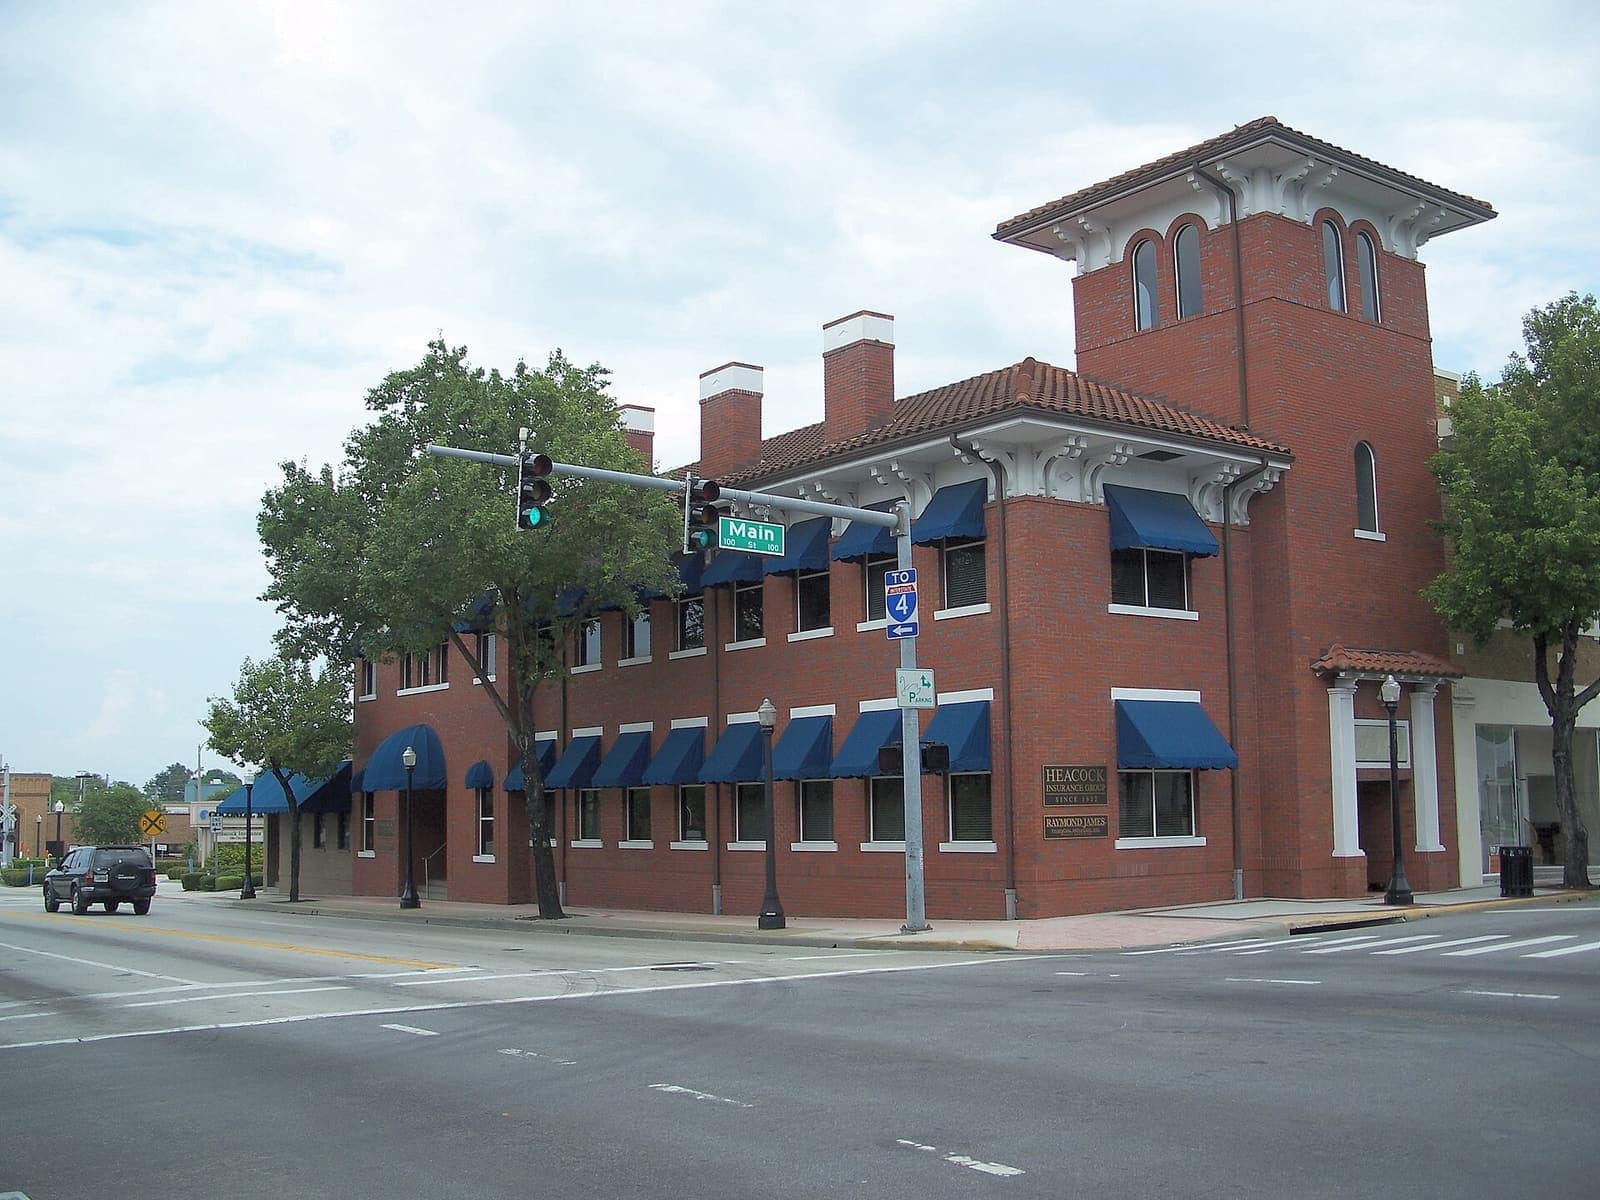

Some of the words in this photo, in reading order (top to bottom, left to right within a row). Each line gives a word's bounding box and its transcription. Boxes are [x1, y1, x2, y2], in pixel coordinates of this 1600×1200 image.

[729, 521, 774, 541] Main
[723, 538, 736, 546] 100
[747, 541, 757, 549] St
[767, 543, 779, 552] 100
[891, 571, 910, 584] TO
[895, 594, 909, 615] 4
[1046, 768, 1105, 782] HEACOCK
[1046, 784, 1084, 793] INSURANCE
[1046, 818, 1083, 828] RAYMOND
[1083, 817, 1106, 828] JAMES
